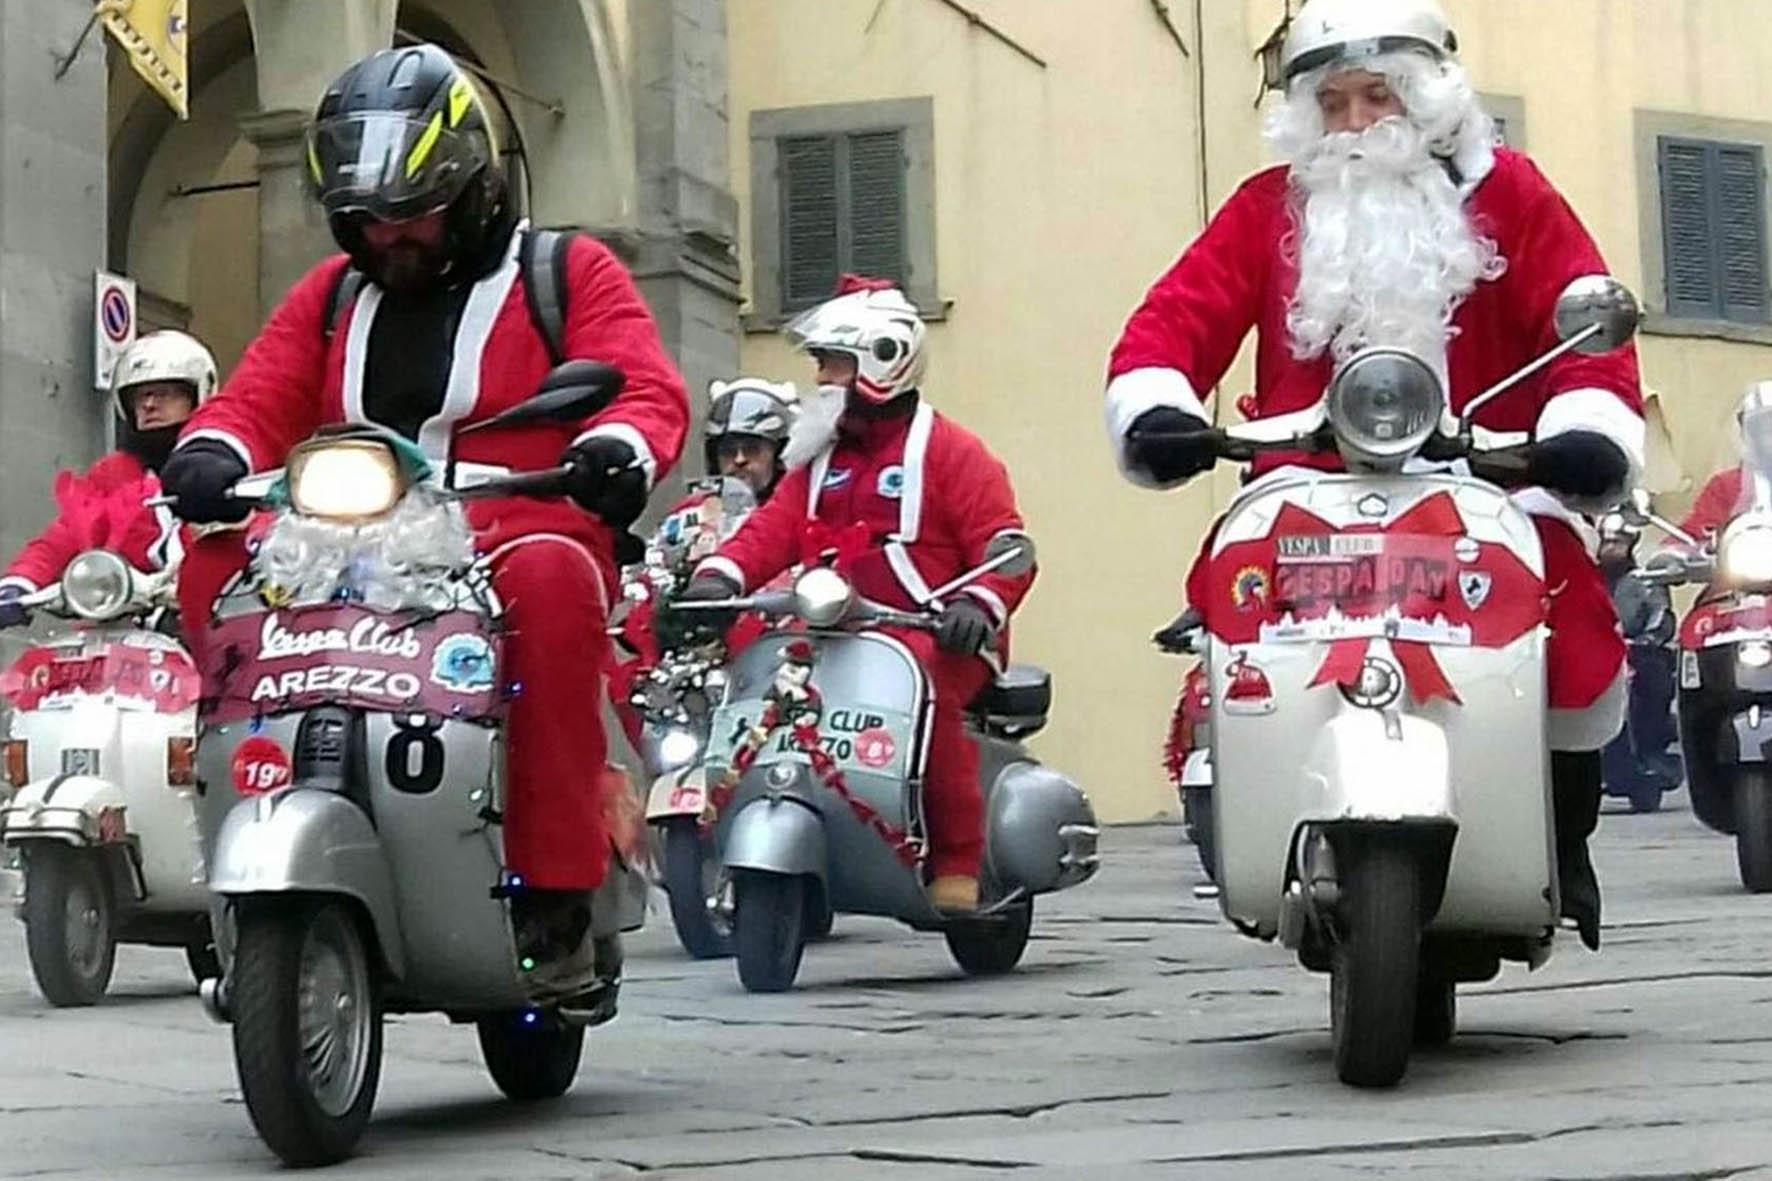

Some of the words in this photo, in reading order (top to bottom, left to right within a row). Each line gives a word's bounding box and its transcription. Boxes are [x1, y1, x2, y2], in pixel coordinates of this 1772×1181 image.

[258, 612, 349, 660] Vespa
[349, 616, 421, 659] Club
[251, 666, 421, 701] AREZZO
[385, 710, 445, 795] 8
